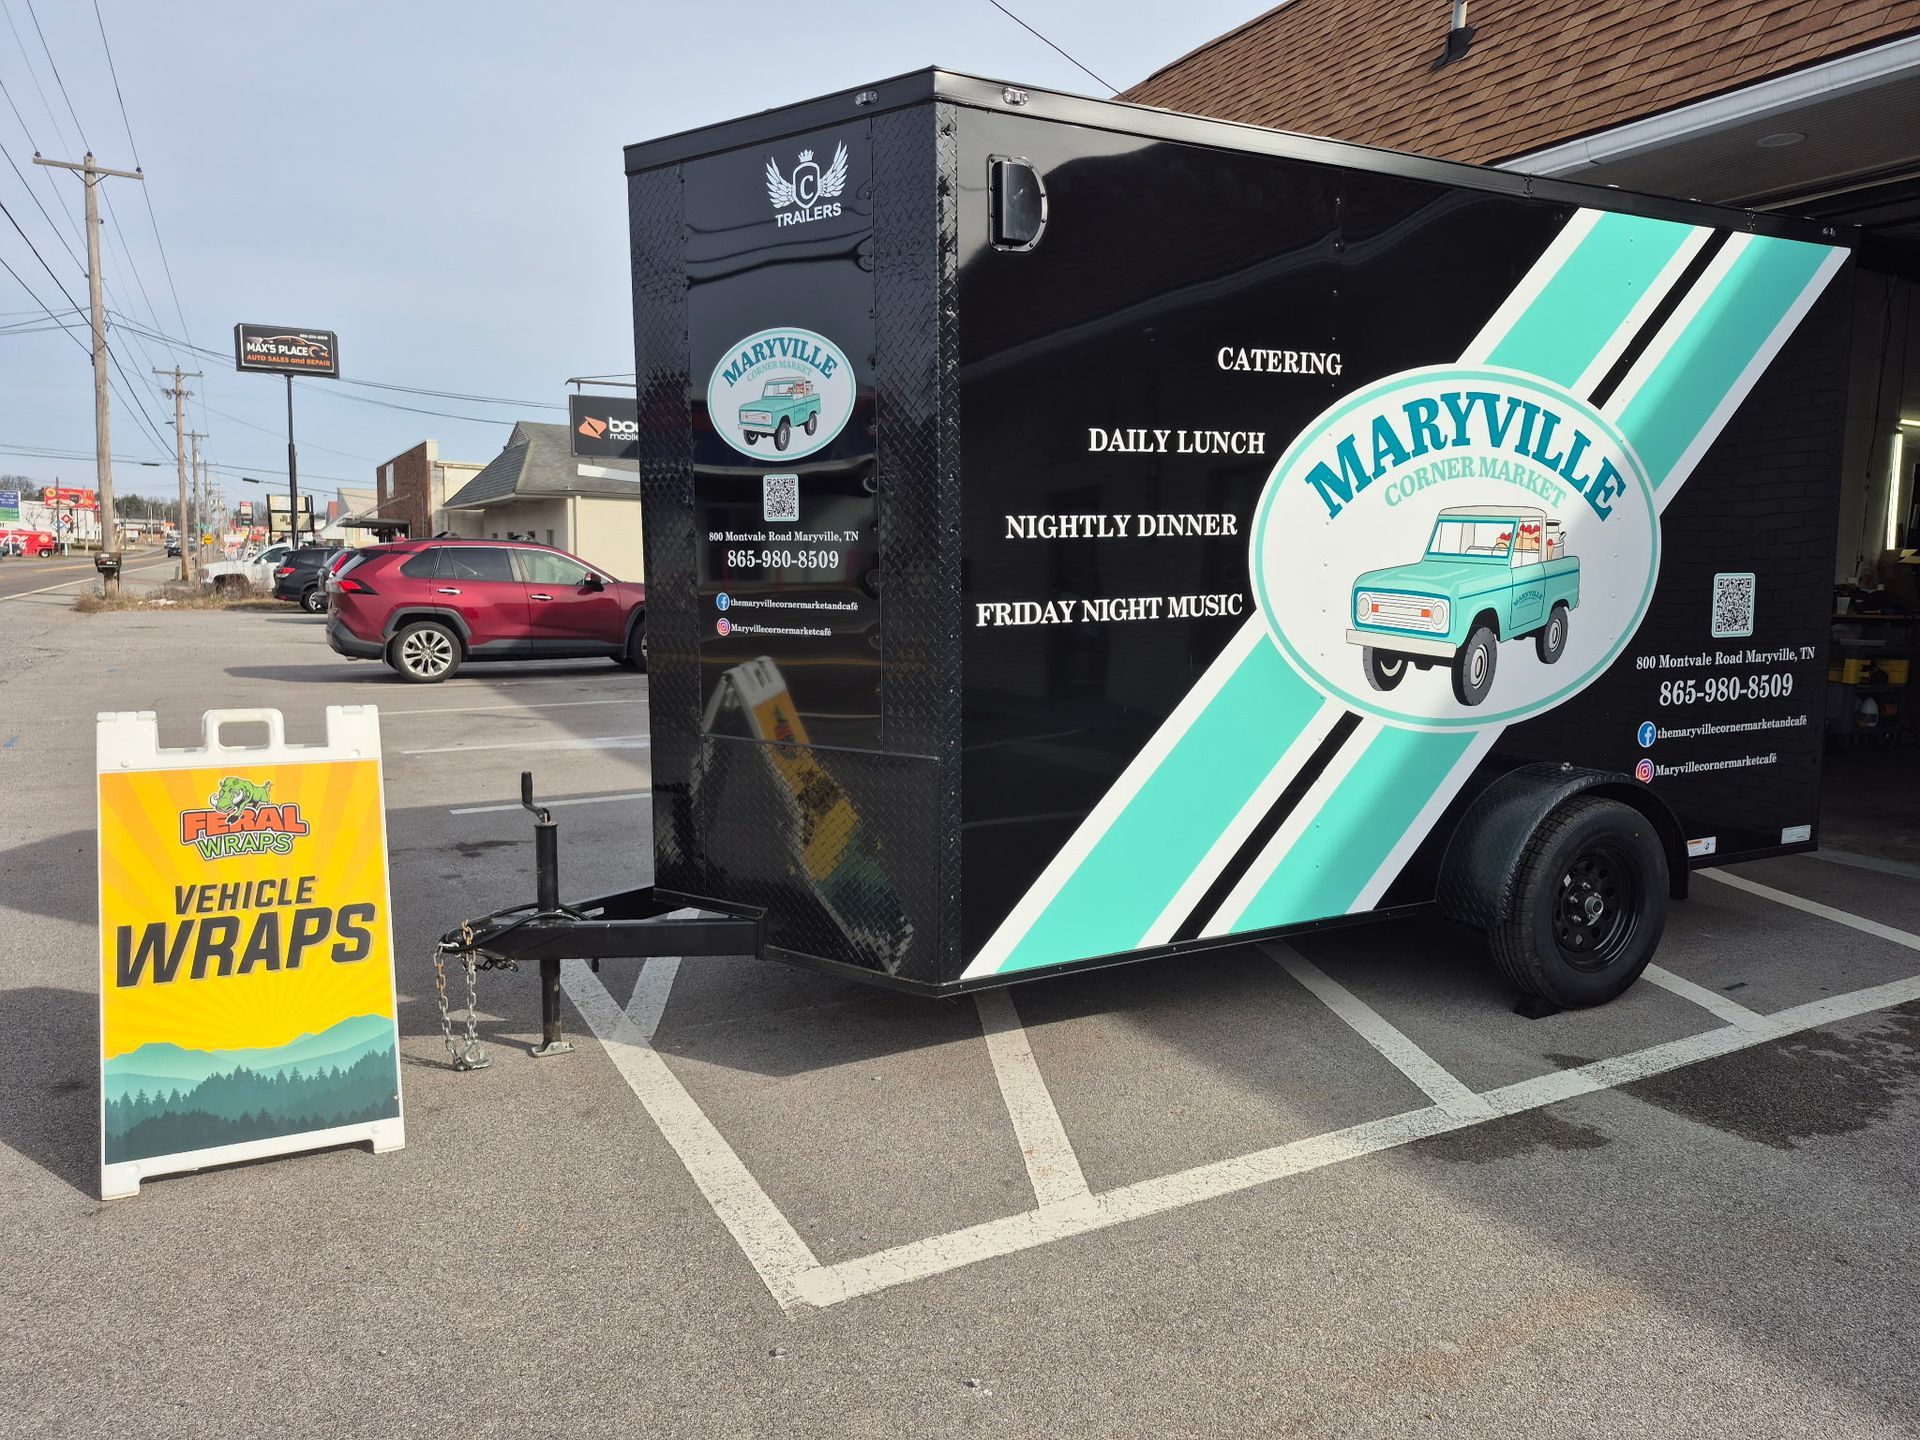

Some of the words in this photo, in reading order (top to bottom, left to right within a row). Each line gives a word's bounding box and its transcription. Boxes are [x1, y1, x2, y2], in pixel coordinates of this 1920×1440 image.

[775, 202, 842, 228] TRAILERS
[246, 342, 276, 354] MAX'S
[278, 344, 308, 356] PLACE
[267, 356, 289, 364] SALES
[290, 357, 306, 365] and
[306, 358, 331, 367] REPAIR
[1217, 346, 1343, 376] CATERING
[722, 337, 838, 388] MARYVILLE
[608, 416, 639, 433] bo
[1088, 427, 1171, 453] DAILY
[1177, 430, 1266, 454] LUNCH
[1304, 391, 1627, 522] MARYVILLE
[1384, 456, 1476, 507] CORNER
[1478, 456, 1567, 509] MARKET
[708, 532, 724, 542] 800
[725, 531, 767, 542] Montvale
[769, 531, 792, 541] Road
[794, 532, 842, 543] Maryville,
[844, 531, 859, 541] TN
[1005, 515, 1132, 539] NIGHTLY
[1137, 514, 1238, 537] DINNER
[727, 550, 839, 569] 865-980-8509
[976, 600, 1077, 627] FRIDAY
[1081, 597, 1163, 622] NIGHT
[1167, 593, 1244, 618] MUSIC
[731, 622, 832, 637] Maryvillecornermarketcafé
[1636, 654, 1656, 670] 800
[1658, 652, 1712, 668] Montvale
[1714, 650, 1743, 665] Road
[1745, 647, 1798, 665] Maryville,
[1800, 646, 1816, 660] TN
[1658, 672, 1794, 706] 865-980-8509
[1657, 715, 1808, 739] themaryvillecornermarketandcafé
[1655, 753, 1777, 776] Maryvillecornermarketcafé
[182, 804, 308, 843] FERAL
[198, 832, 293, 860] WRAPS
[174, 876, 315, 915] VEHICLE
[116, 902, 377, 988] WRAPS
